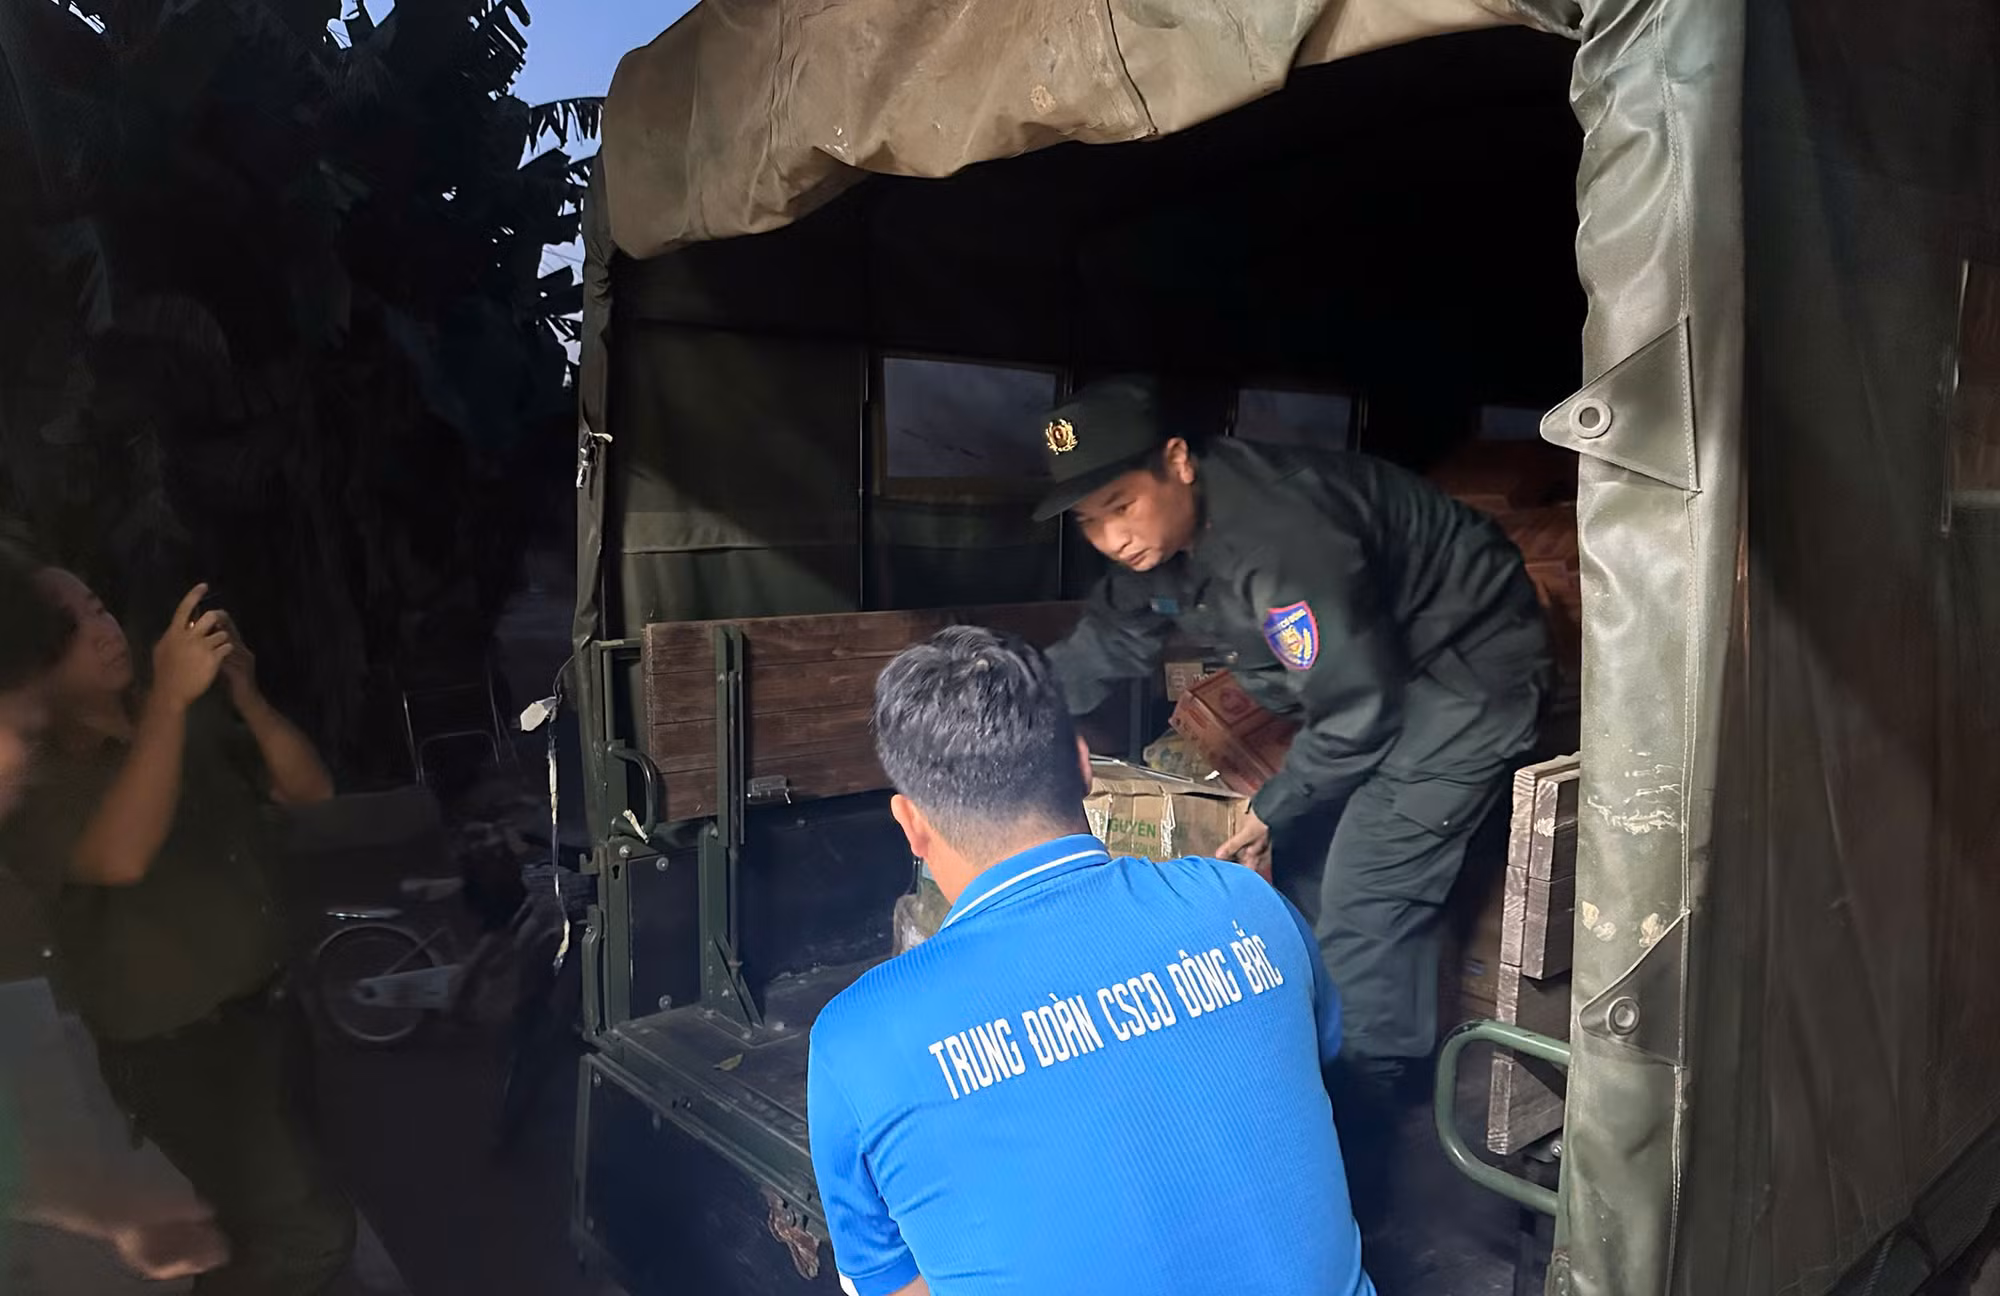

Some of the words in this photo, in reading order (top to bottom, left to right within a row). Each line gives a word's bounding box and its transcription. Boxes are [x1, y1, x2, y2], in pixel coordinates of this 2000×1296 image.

[928, 1018, 1026, 1100] TRUNG
[1021, 992, 1105, 1068] ĐOÀN
[1096, 971, 1177, 1042] CSCĐ
[1166, 949, 1243, 1018] ĐÔNG
[1230, 918, 1284, 995] BẮC
